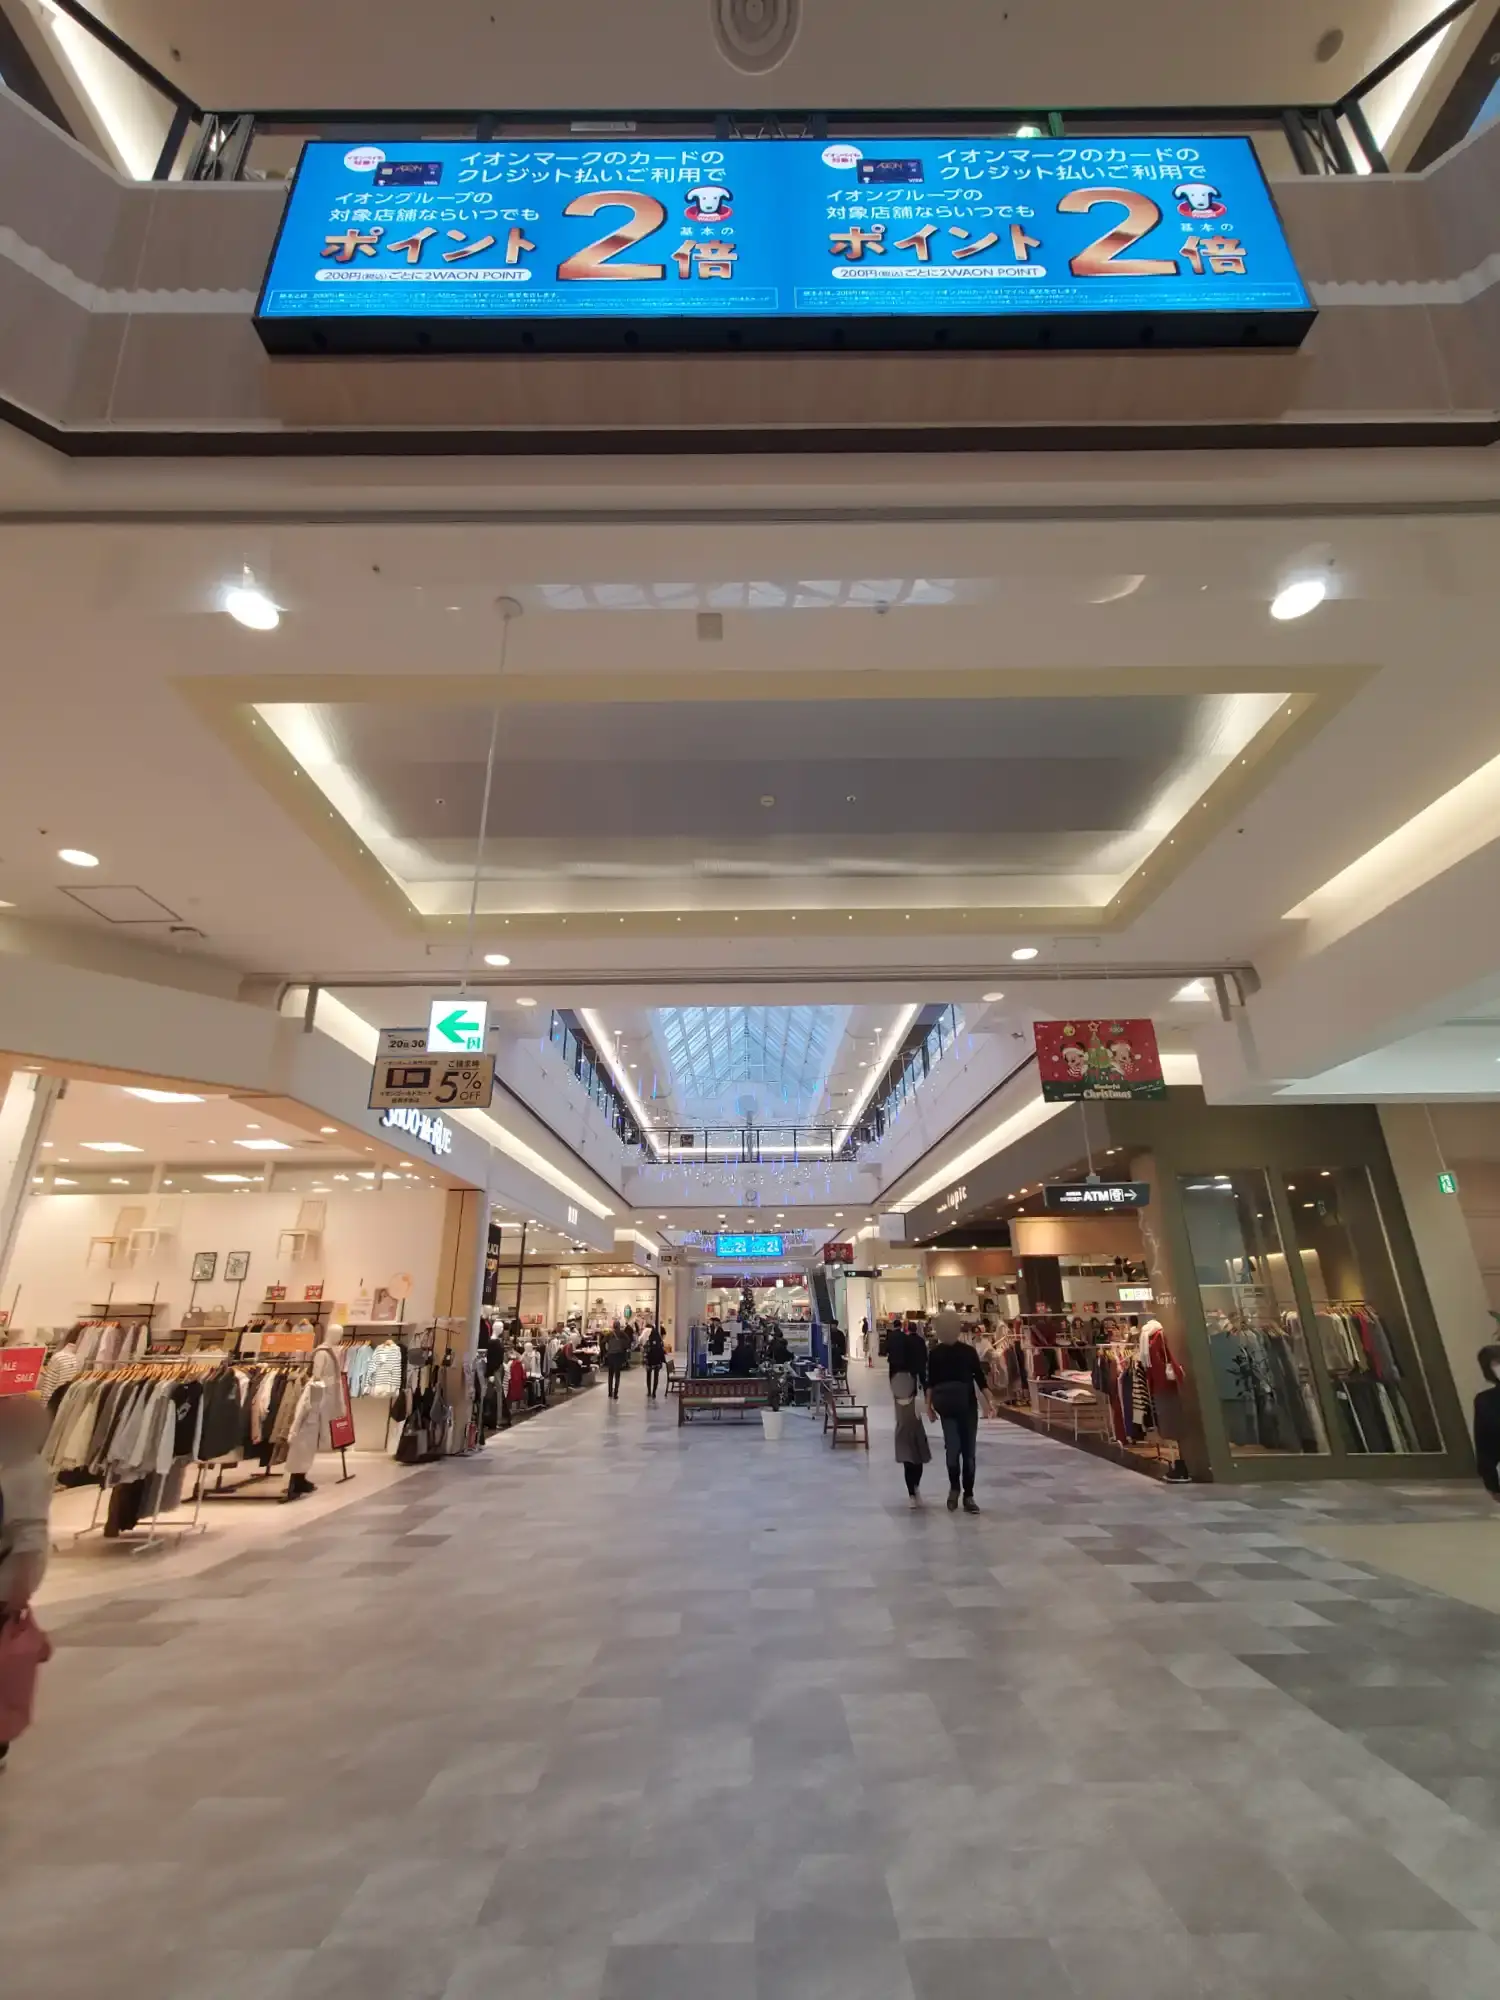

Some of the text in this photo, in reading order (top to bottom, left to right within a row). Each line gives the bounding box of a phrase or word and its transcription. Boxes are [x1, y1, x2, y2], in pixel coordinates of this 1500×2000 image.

[460, 150, 725, 166] イオンマークのカードの
[937, 148, 1200, 164] イオンマークのカードの
[458, 167, 727, 184] クレジット払いご利用で
[940, 165, 1207, 181] クレジット払いご利用で
[335, 191, 493, 206] イオングループの
[826, 188, 984, 203] イオングループの
[328, 208, 540, 222] 対象店舗ならいつでも
[826, 205, 1036, 220] 対象店舗ならいつでも
[319, 225, 537, 264] ポイント
[827, 223, 1042, 262] ポイント
[482, 271, 527, 281] POINT
[999, 267, 1040, 278] POINT
[411, 1038, 426, 1048] 30
[459, 1091, 481, 1101] OFF
[1083, 1089, 1132, 1100] Christmas
[1083, 1191, 1110, 1202] ATM
[14, 1373, 35, 1383] SALE
